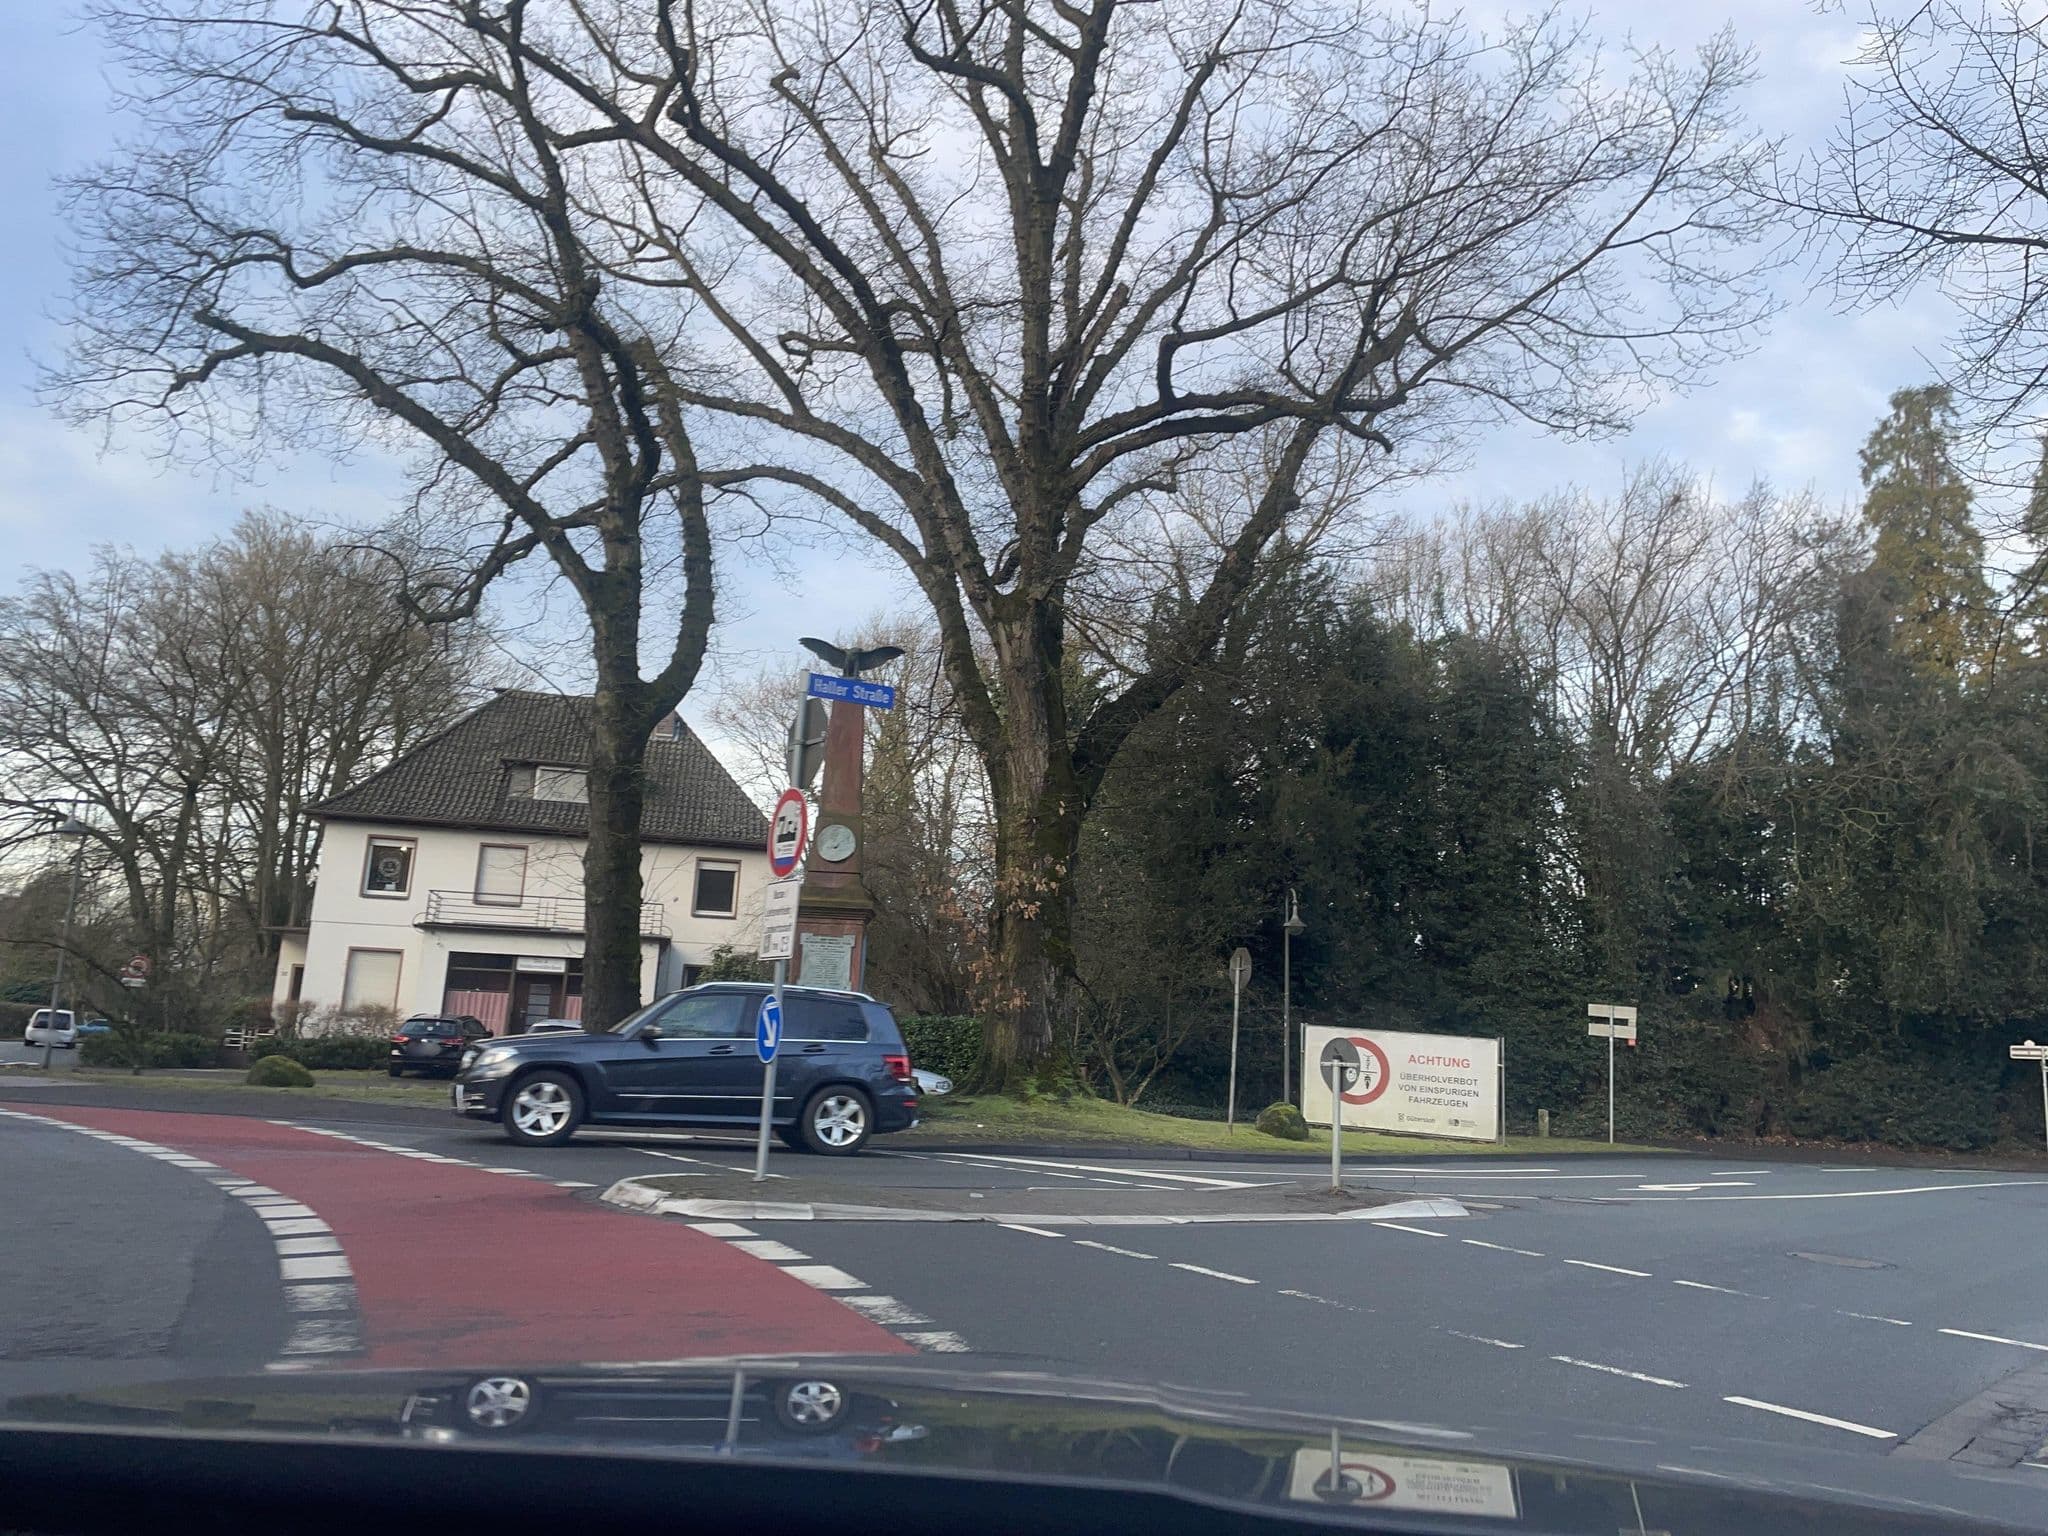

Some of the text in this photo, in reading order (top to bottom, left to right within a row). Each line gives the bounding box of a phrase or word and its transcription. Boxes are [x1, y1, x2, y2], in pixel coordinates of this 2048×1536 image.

[814, 678, 889, 704] Haller Straße
[1408, 1054, 1470, 1069] ACHTUNG
[1400, 1072, 1478, 1087] ÜBERHOLVERBOT
[1398, 1083, 1479, 1098] VON EINSPURIGEN
[1408, 1095, 1468, 1108] FAHRZEUGEN
